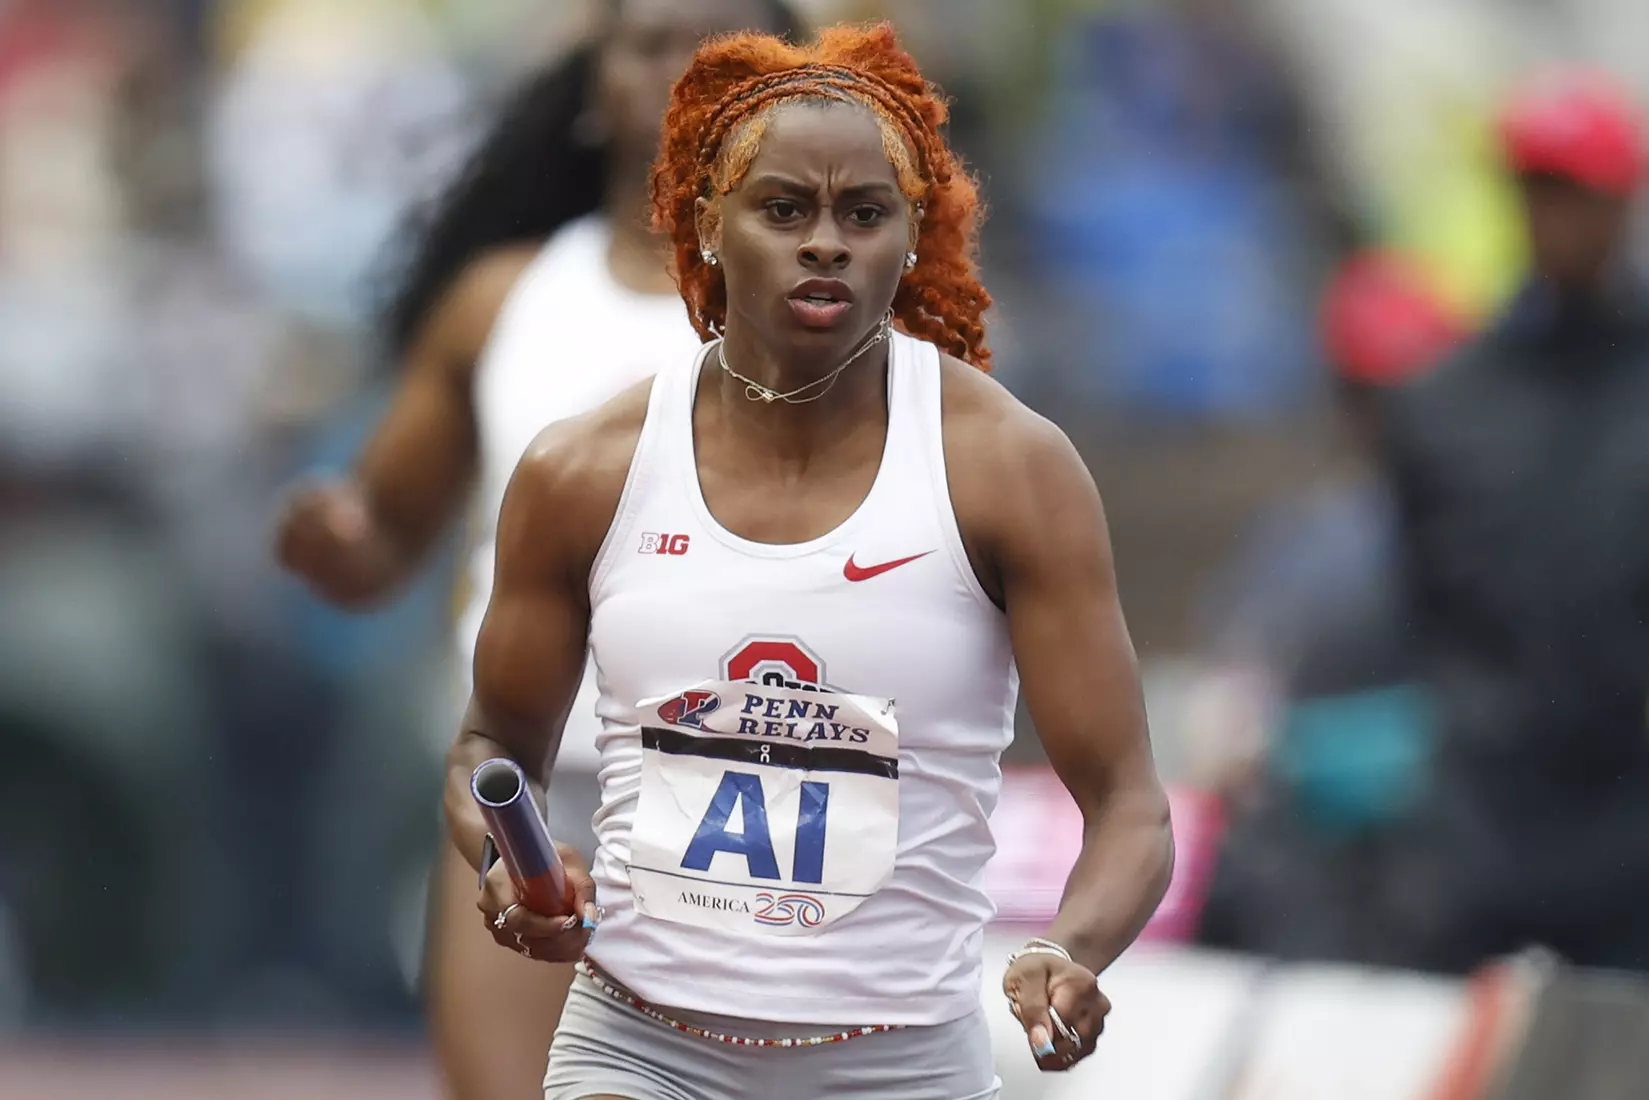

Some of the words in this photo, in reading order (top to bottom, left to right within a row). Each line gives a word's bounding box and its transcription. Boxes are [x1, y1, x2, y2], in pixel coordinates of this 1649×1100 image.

[740, 693, 839, 720] PENN
[736, 716, 870, 743] RELAYS
[679, 770, 830, 884] AI
[677, 891, 750, 913] AMERICA
[754, 892, 826, 928] 250
